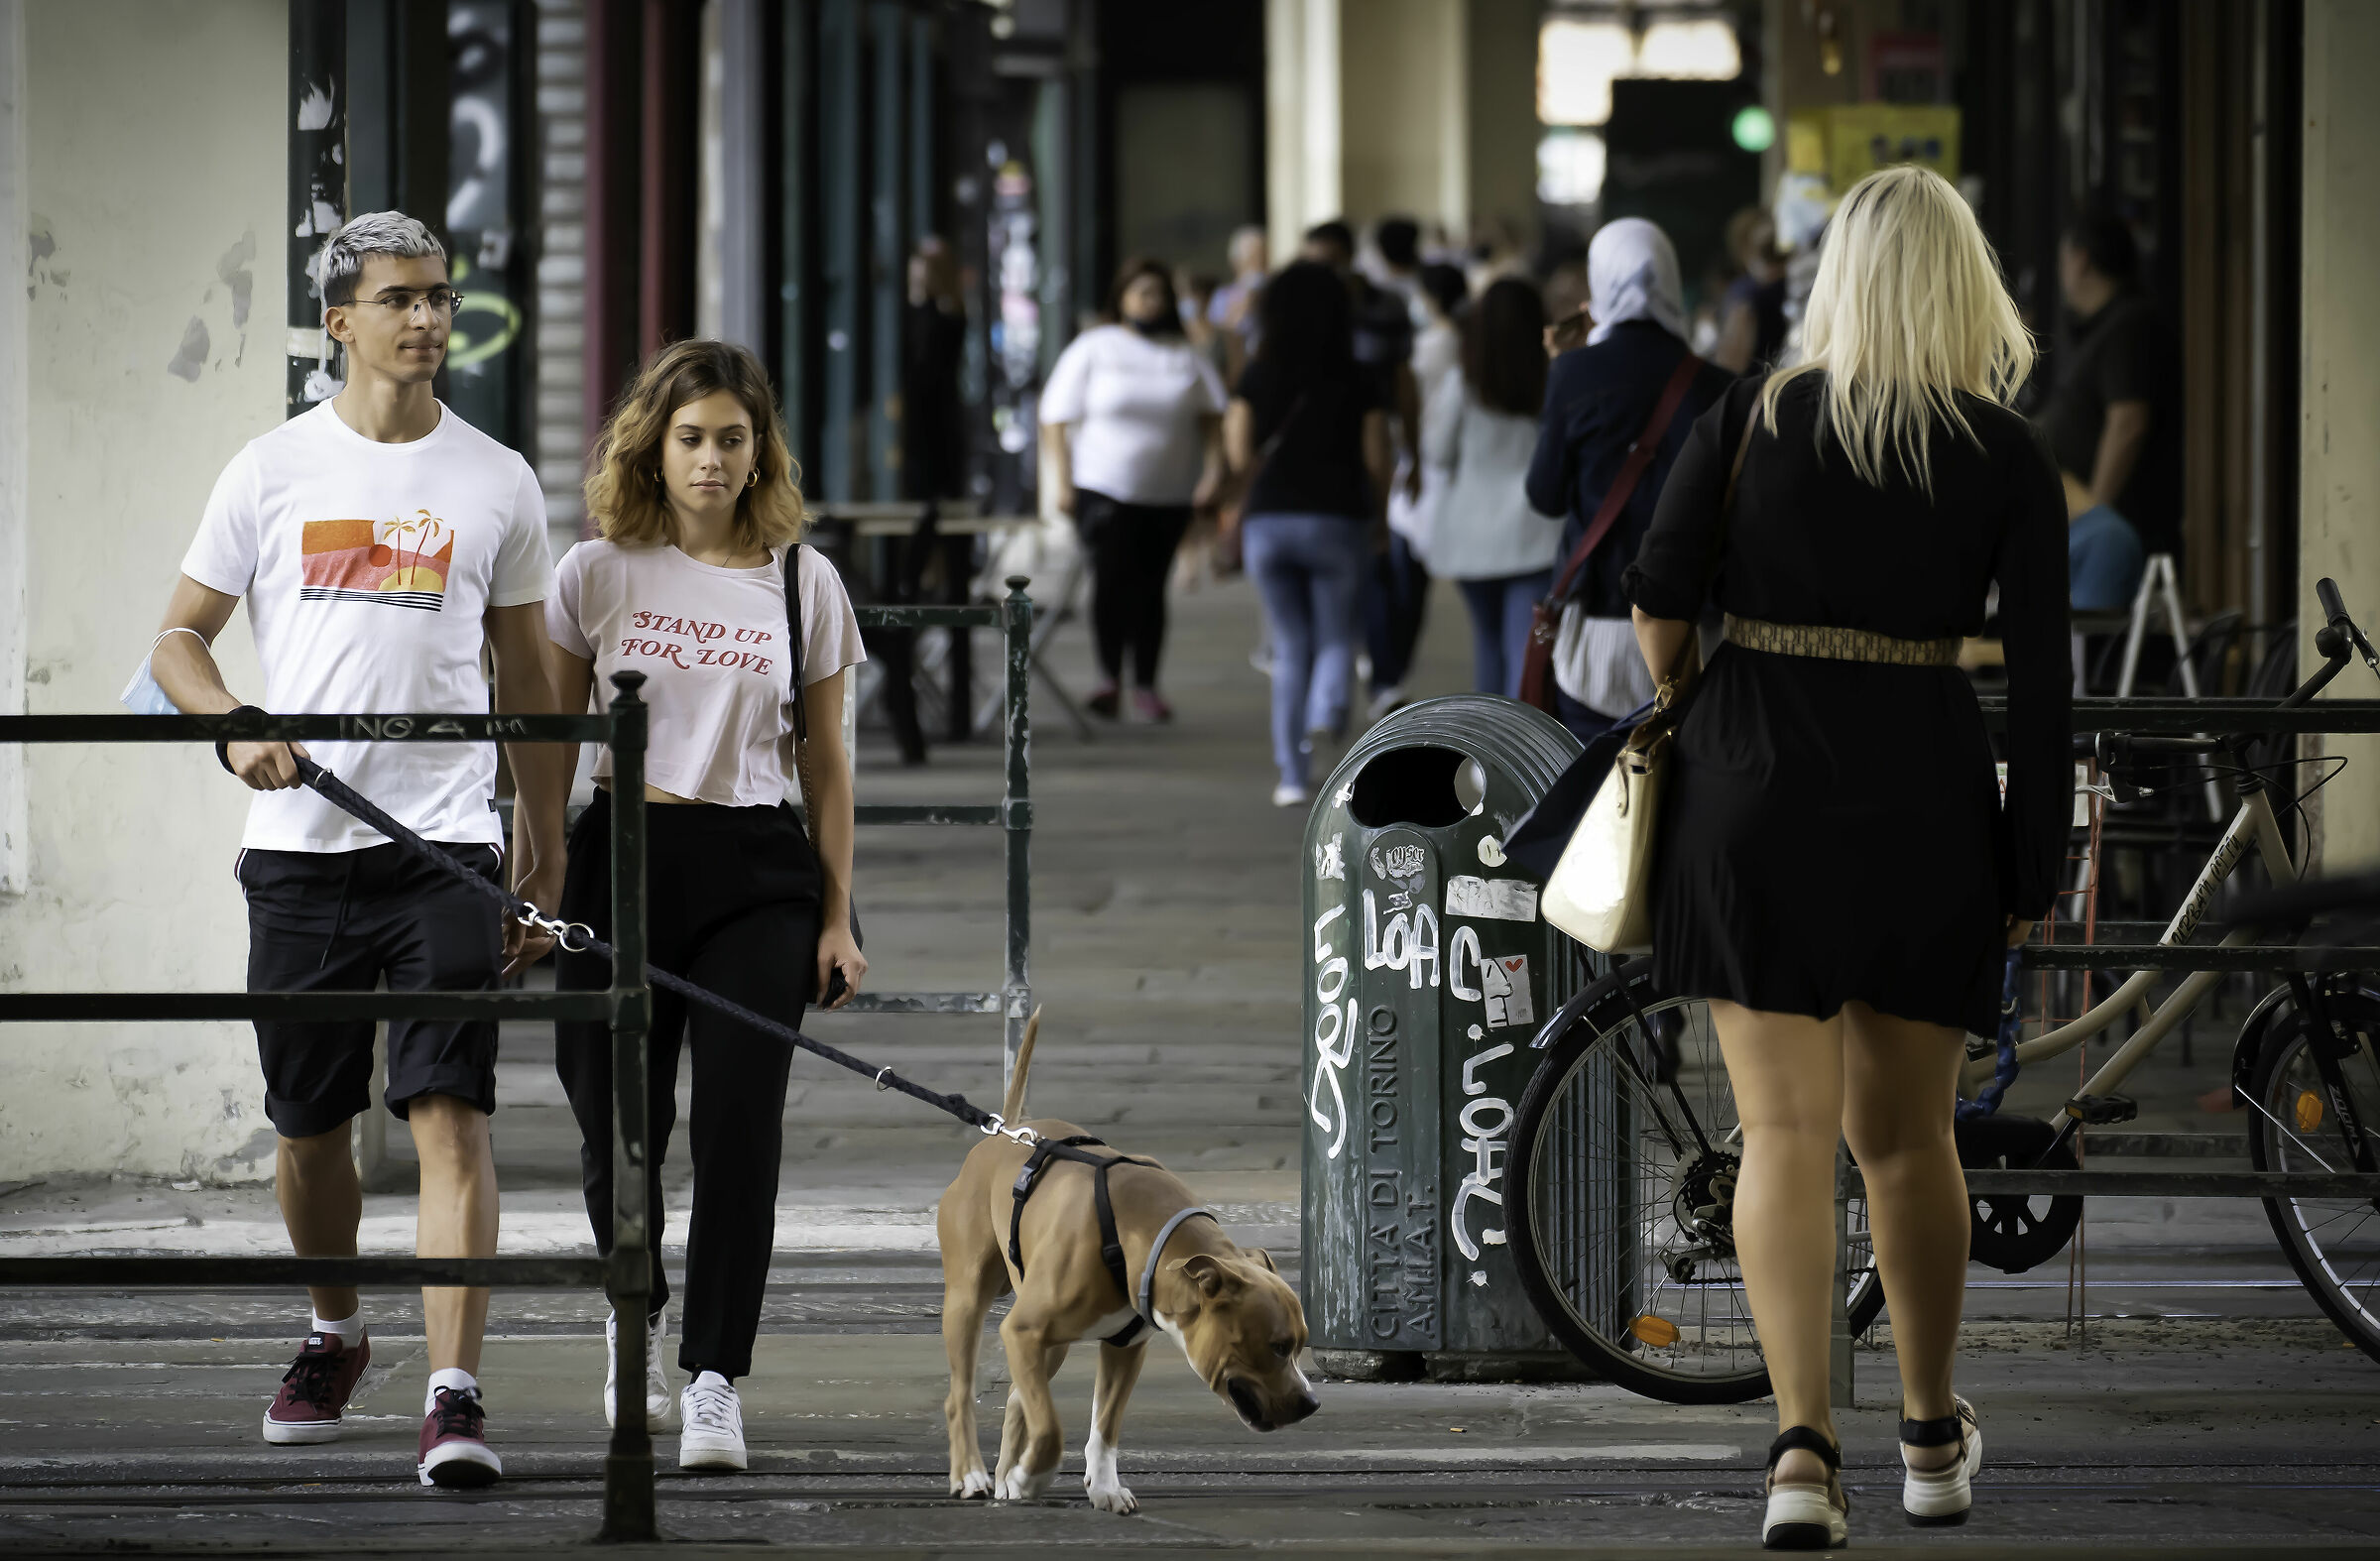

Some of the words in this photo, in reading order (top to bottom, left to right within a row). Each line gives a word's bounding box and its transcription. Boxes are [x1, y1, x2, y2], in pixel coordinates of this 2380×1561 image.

[632, 610, 727, 645] STAND
[734, 628, 773, 645] UP
[621, 638, 691, 670] FOR
[696, 649, 774, 676] LOVE
[1369, 1005, 1398, 1155] TORINO
[1369, 1169, 1400, 1208] DI
